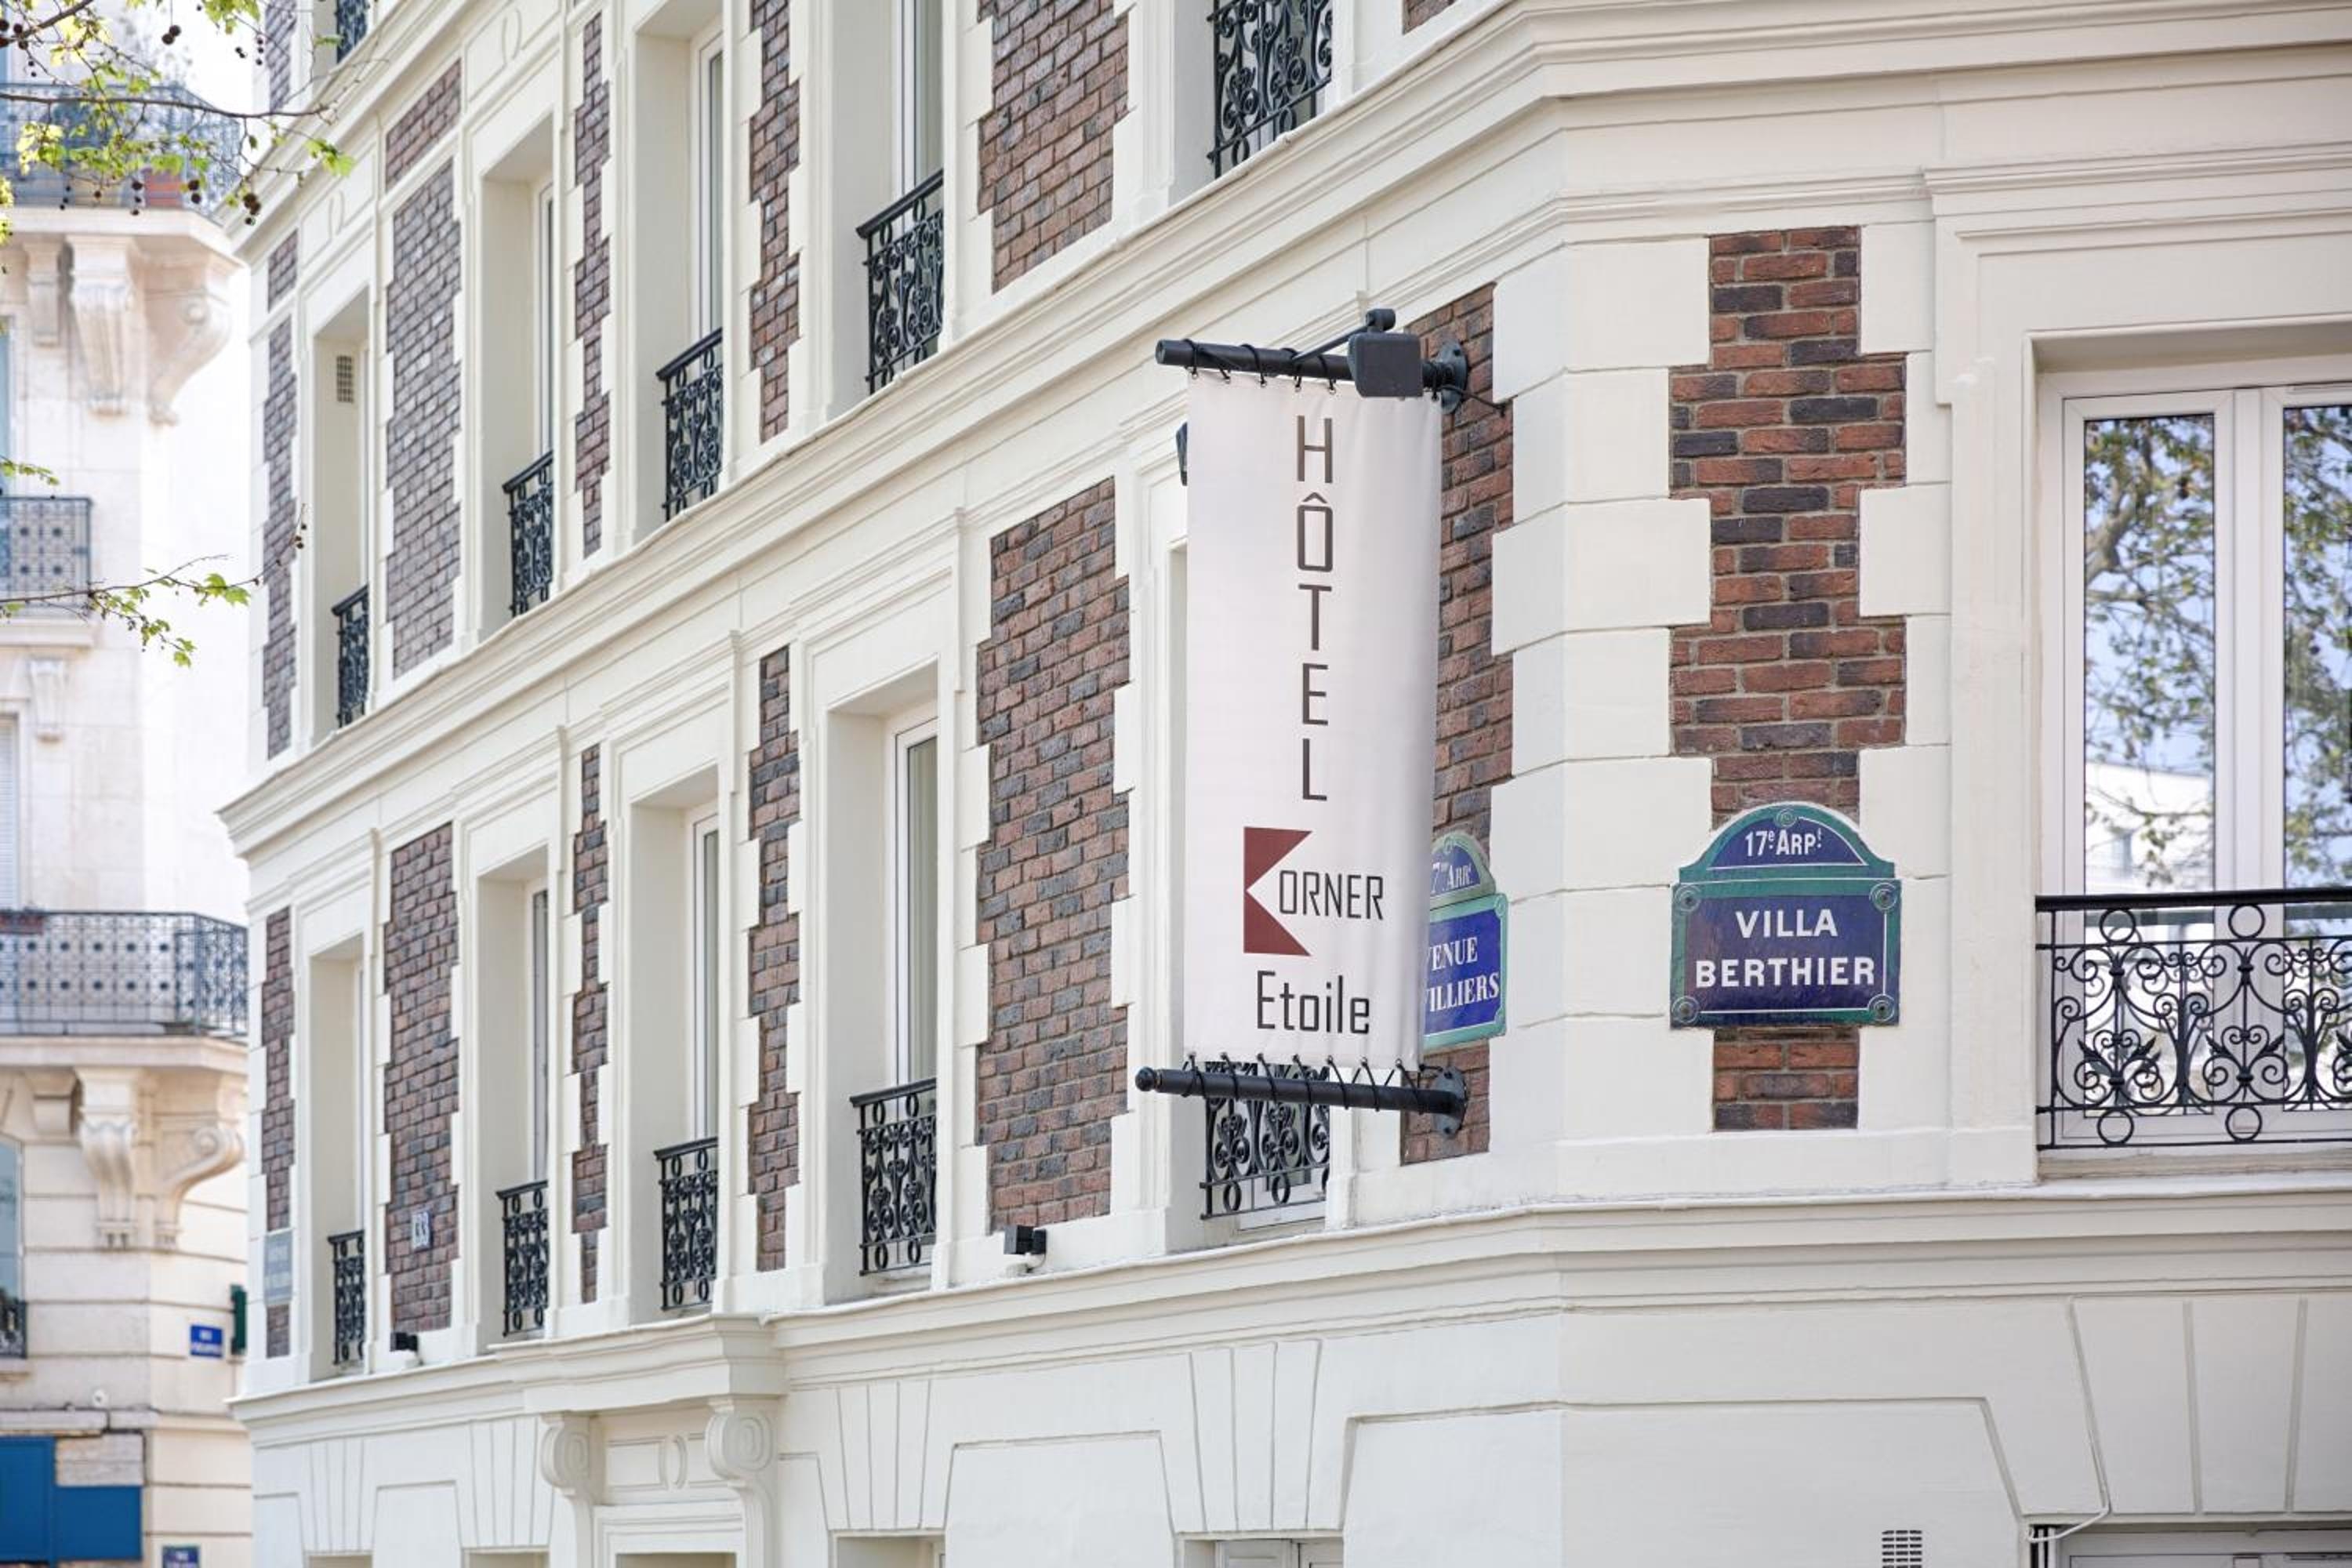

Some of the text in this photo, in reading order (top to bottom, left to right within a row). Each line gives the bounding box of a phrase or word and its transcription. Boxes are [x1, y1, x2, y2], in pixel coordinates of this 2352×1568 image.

[1296, 415, 1334, 801] HÔTEL
[1735, 909, 1838, 938] VILLA
[1695, 956, 1875, 989] BERTHIER
[1257, 970, 1370, 1034] Etoile
